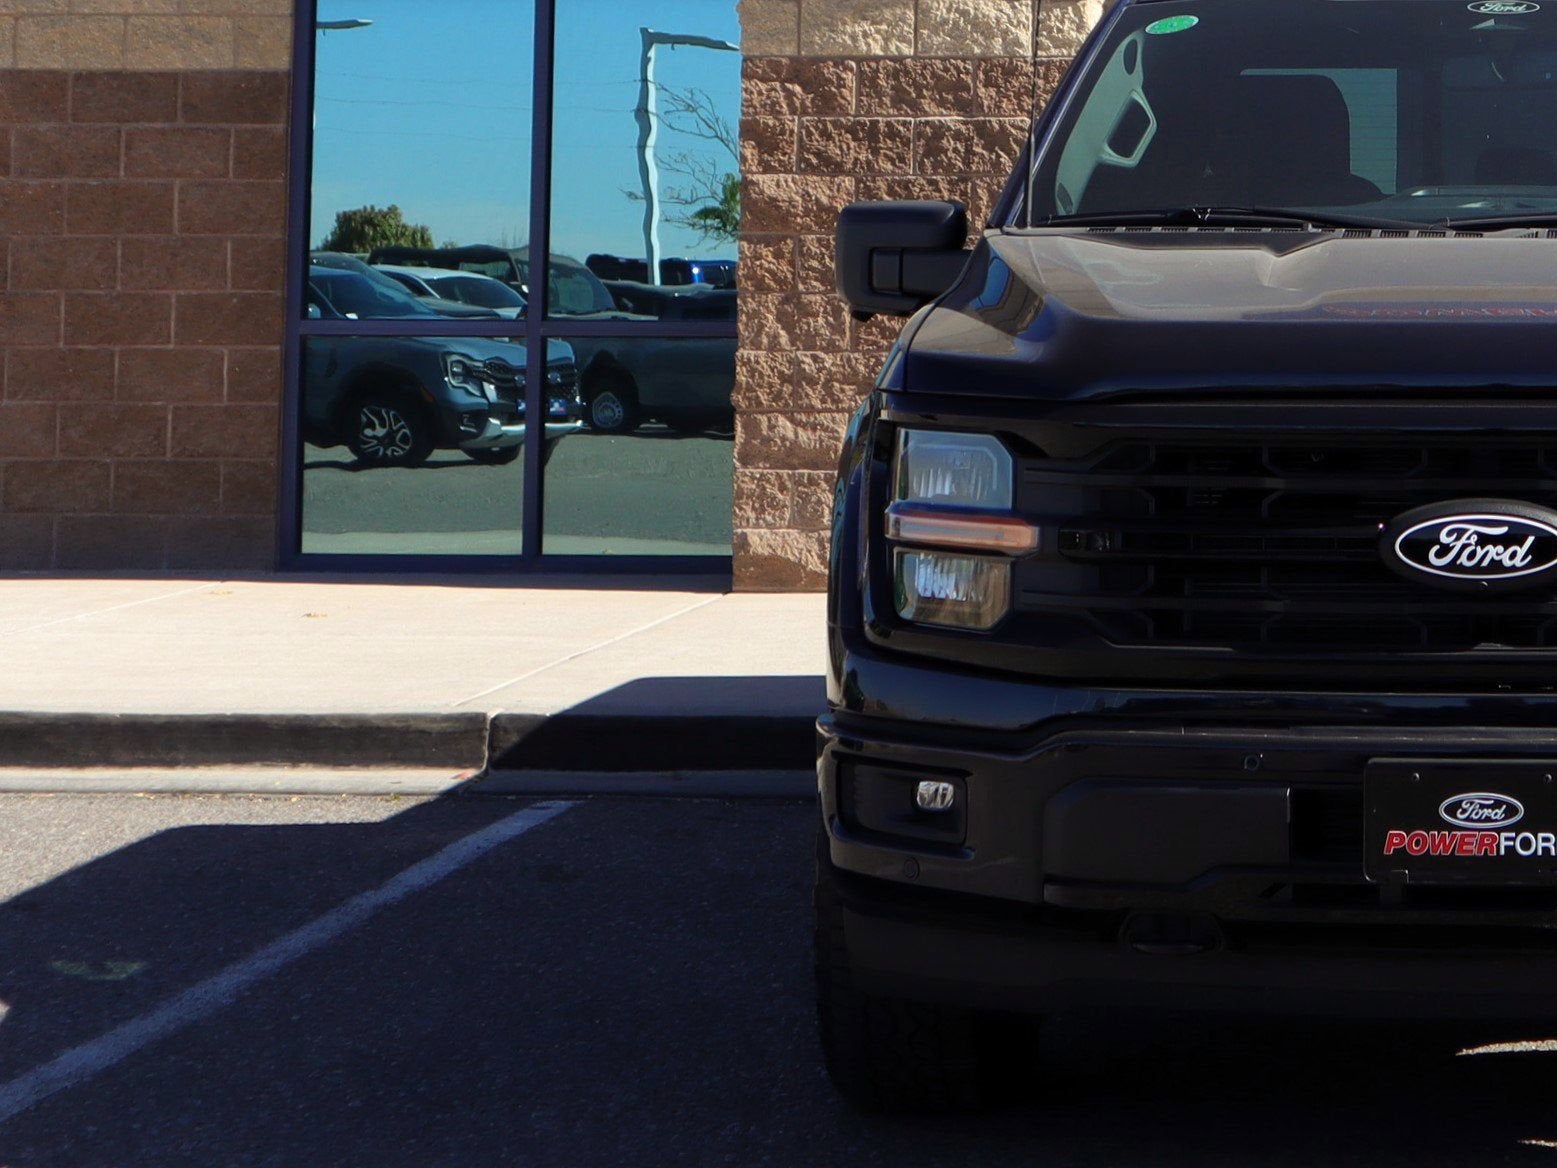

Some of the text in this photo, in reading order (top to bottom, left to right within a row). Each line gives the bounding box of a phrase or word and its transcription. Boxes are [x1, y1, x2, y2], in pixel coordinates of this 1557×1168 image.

[1480, 1, 1528, 12] Ford
[1428, 523, 1535, 567] Ford
[1456, 799, 1507, 821] Ford
